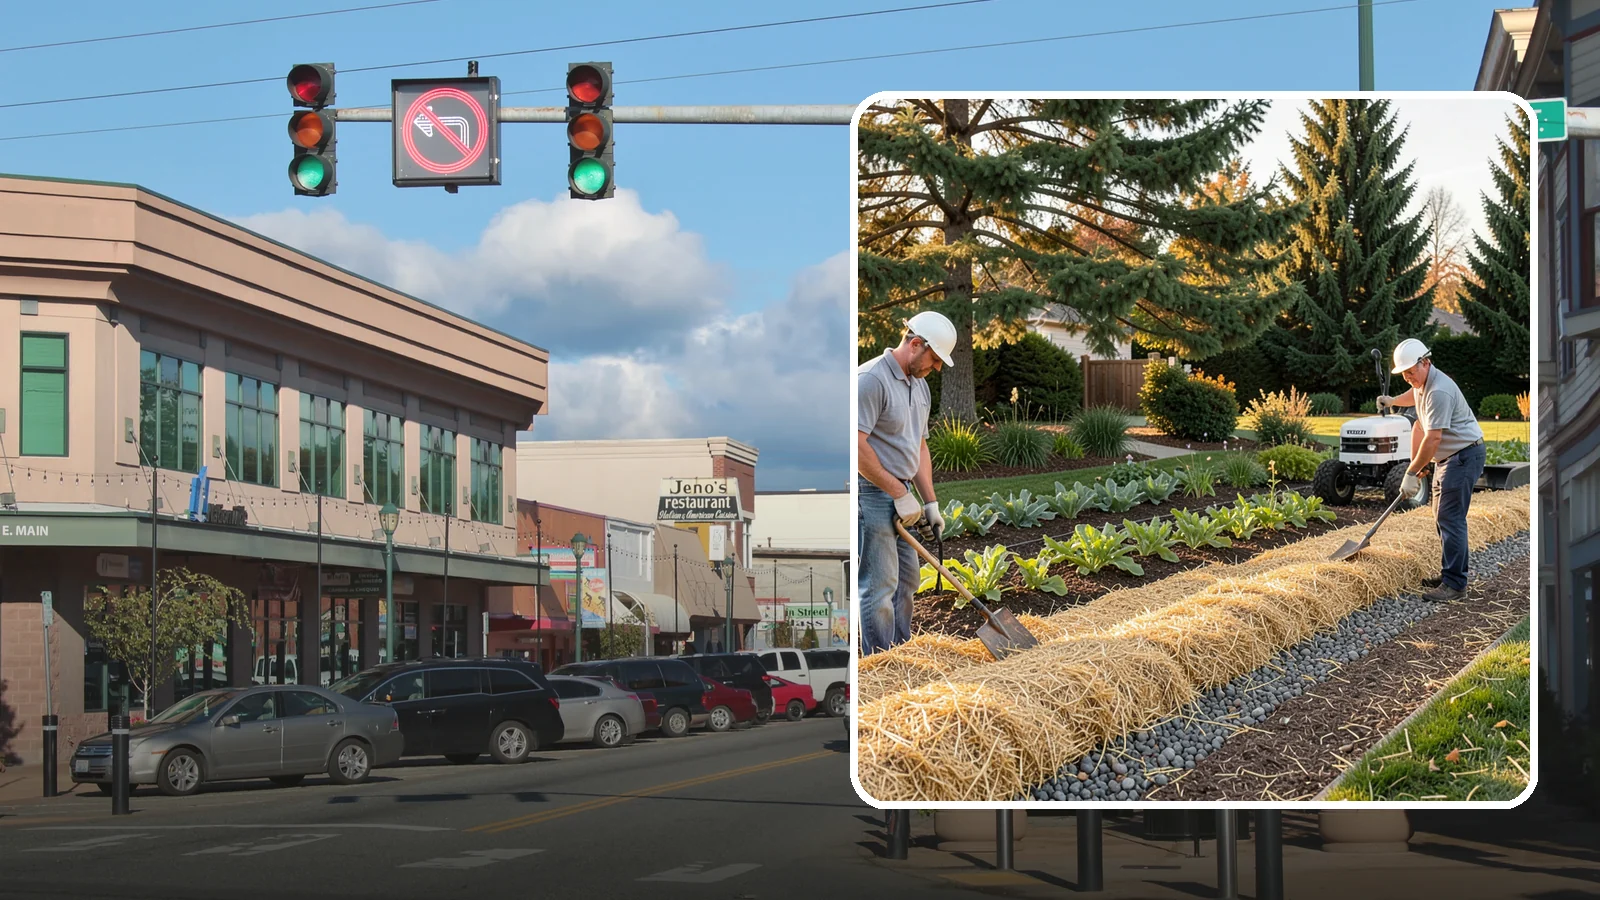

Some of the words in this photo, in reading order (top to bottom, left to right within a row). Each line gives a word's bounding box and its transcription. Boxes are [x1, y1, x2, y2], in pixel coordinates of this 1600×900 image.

[670, 480, 727, 494] Jeno's
[665, 496, 731, 509] restaurant
[715, 509, 737, 519] Cuisine
[15, 525, 49, 536] MAIN
[797, 607, 828, 617] Street
